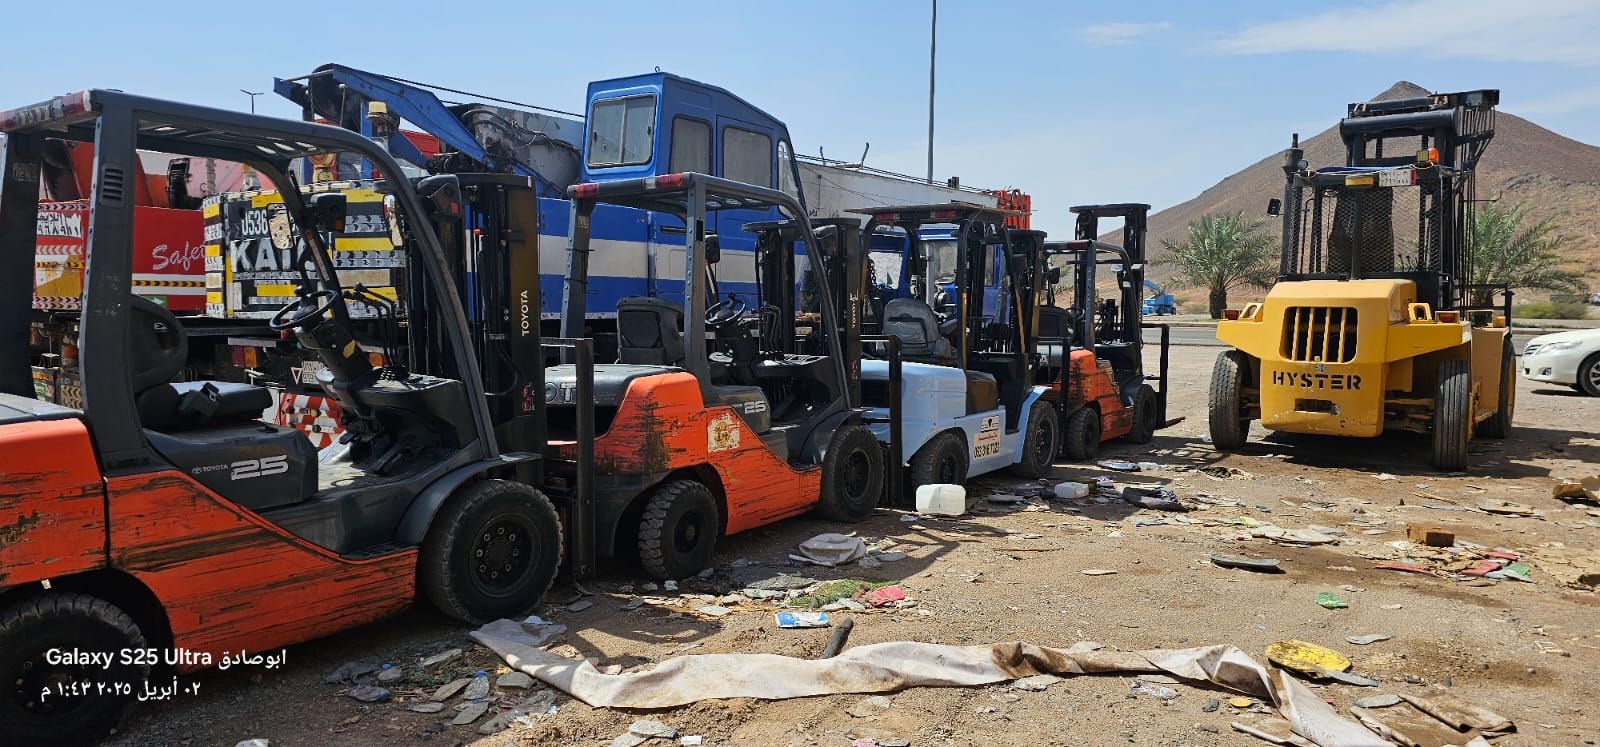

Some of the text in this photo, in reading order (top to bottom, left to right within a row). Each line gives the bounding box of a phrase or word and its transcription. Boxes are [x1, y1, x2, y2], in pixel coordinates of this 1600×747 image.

[520, 290, 530, 337] TOYOTA
[1273, 370, 1362, 390] HYSTER
[744, 400, 766, 414] 25
[202, 454, 289, 480] TOYOTA 25
